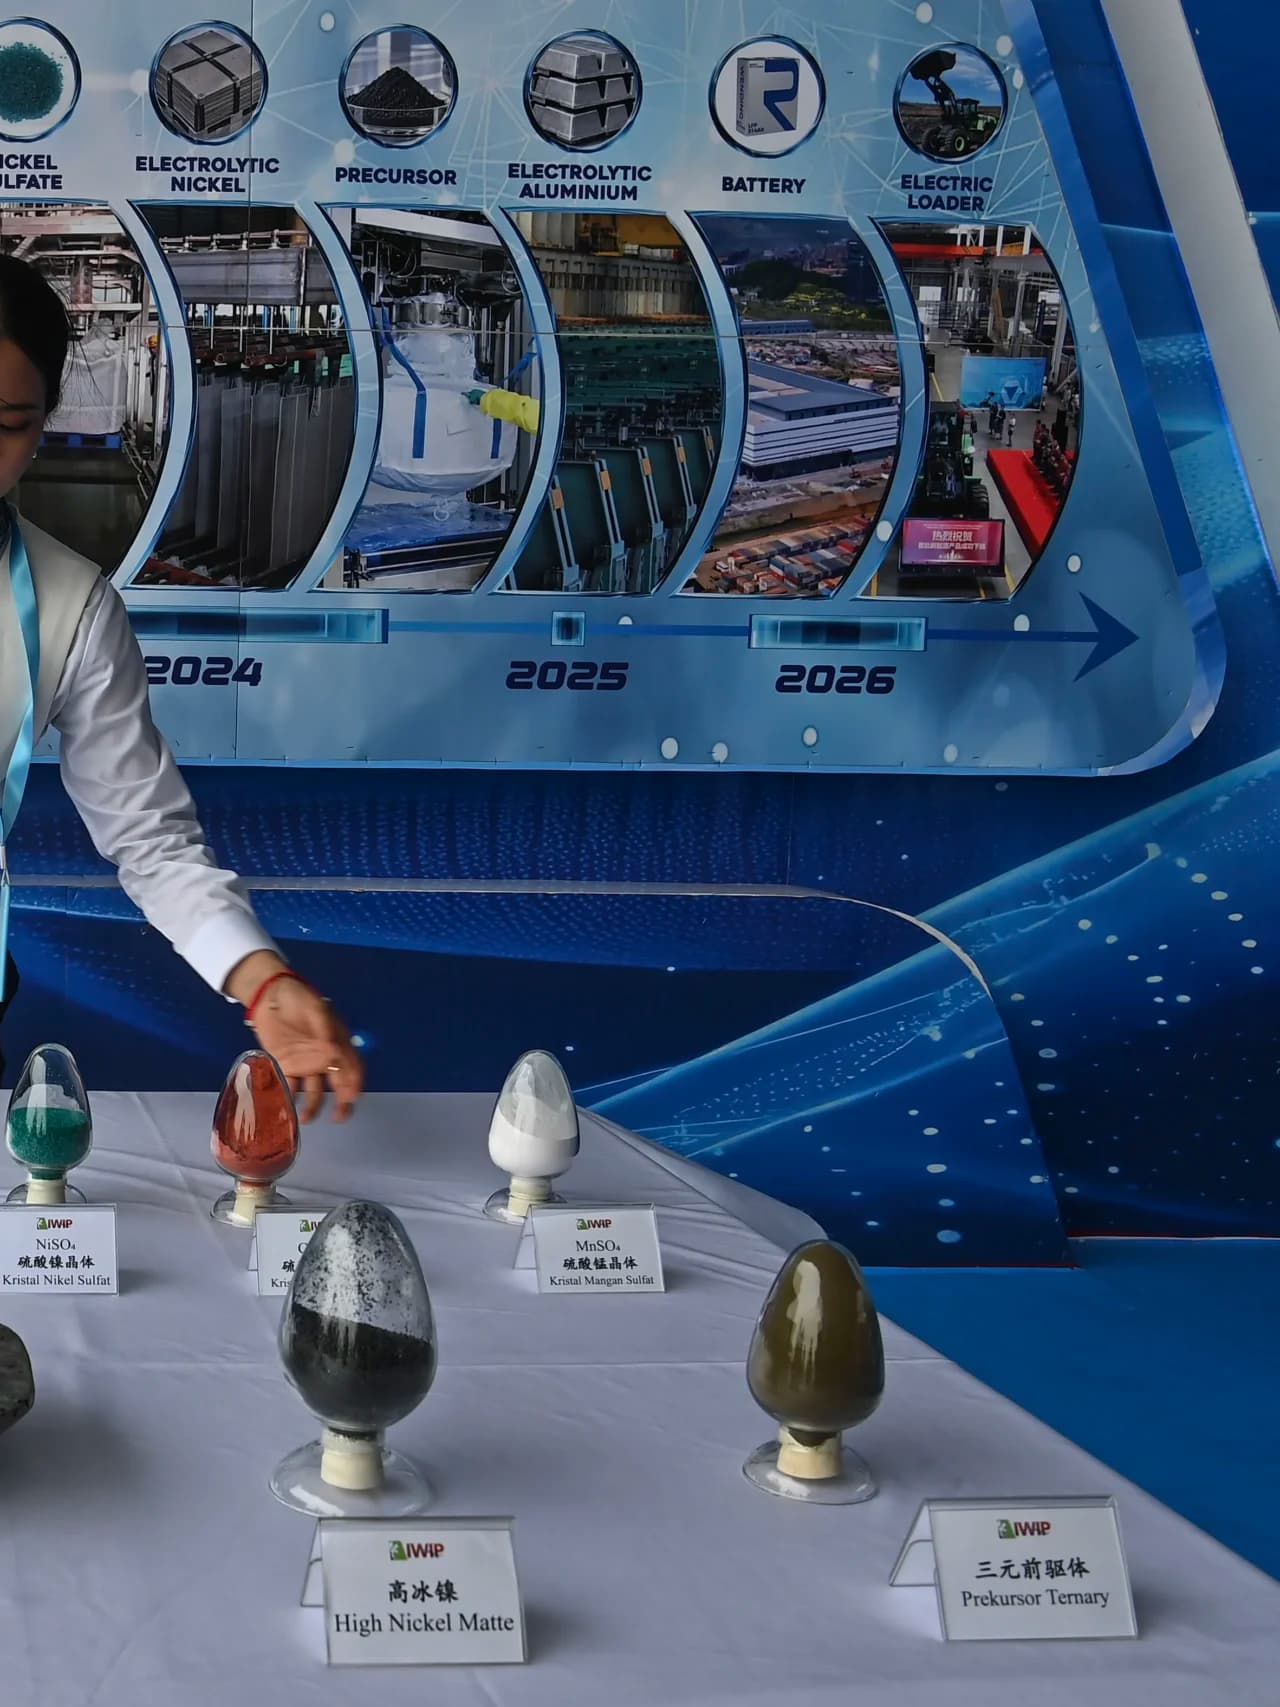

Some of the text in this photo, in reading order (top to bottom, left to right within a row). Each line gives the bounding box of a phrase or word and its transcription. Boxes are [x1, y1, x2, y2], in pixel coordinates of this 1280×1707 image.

[135, 156, 280, 174] ELECTROLYTIC
[507, 163, 653, 181] ELECTROLYTIC
[170, 176, 246, 193] NICKEL
[334, 167, 458, 186] PRECURSOR
[721, 176, 806, 194] BATTERY
[900, 174, 994, 192] ELECTRIC
[519, 183, 638, 201] ALUMINIUM
[906, 194, 985, 212] LOADER
[144, 656, 263, 687] 2024
[505, 661, 629, 692] 2025
[775, 665, 897, 695] 2026
[48, 1218, 73, 1229] IWIP
[588, 1219, 612, 1229] IWIP
[17, 1254, 95, 1270] 硫酸镍晶体
[563, 1256, 638, 1270] 硫酸锰晶体
[2, 1274, 111, 1286] Kristal Nikel Sulfat
[550, 1274, 654, 1288] Kristal Mangan Sulfat
[1014, 1521, 1052, 1536] IWIP
[406, 1543, 445, 1558] IWIP
[975, 1556, 1090, 1580] 三元前驱体
[388, 1578, 459, 1603] 高冰镍
[961, 1588, 1110, 1608] Prekursor Ternary
[334, 1612, 515, 1637] High Nickel Matte
